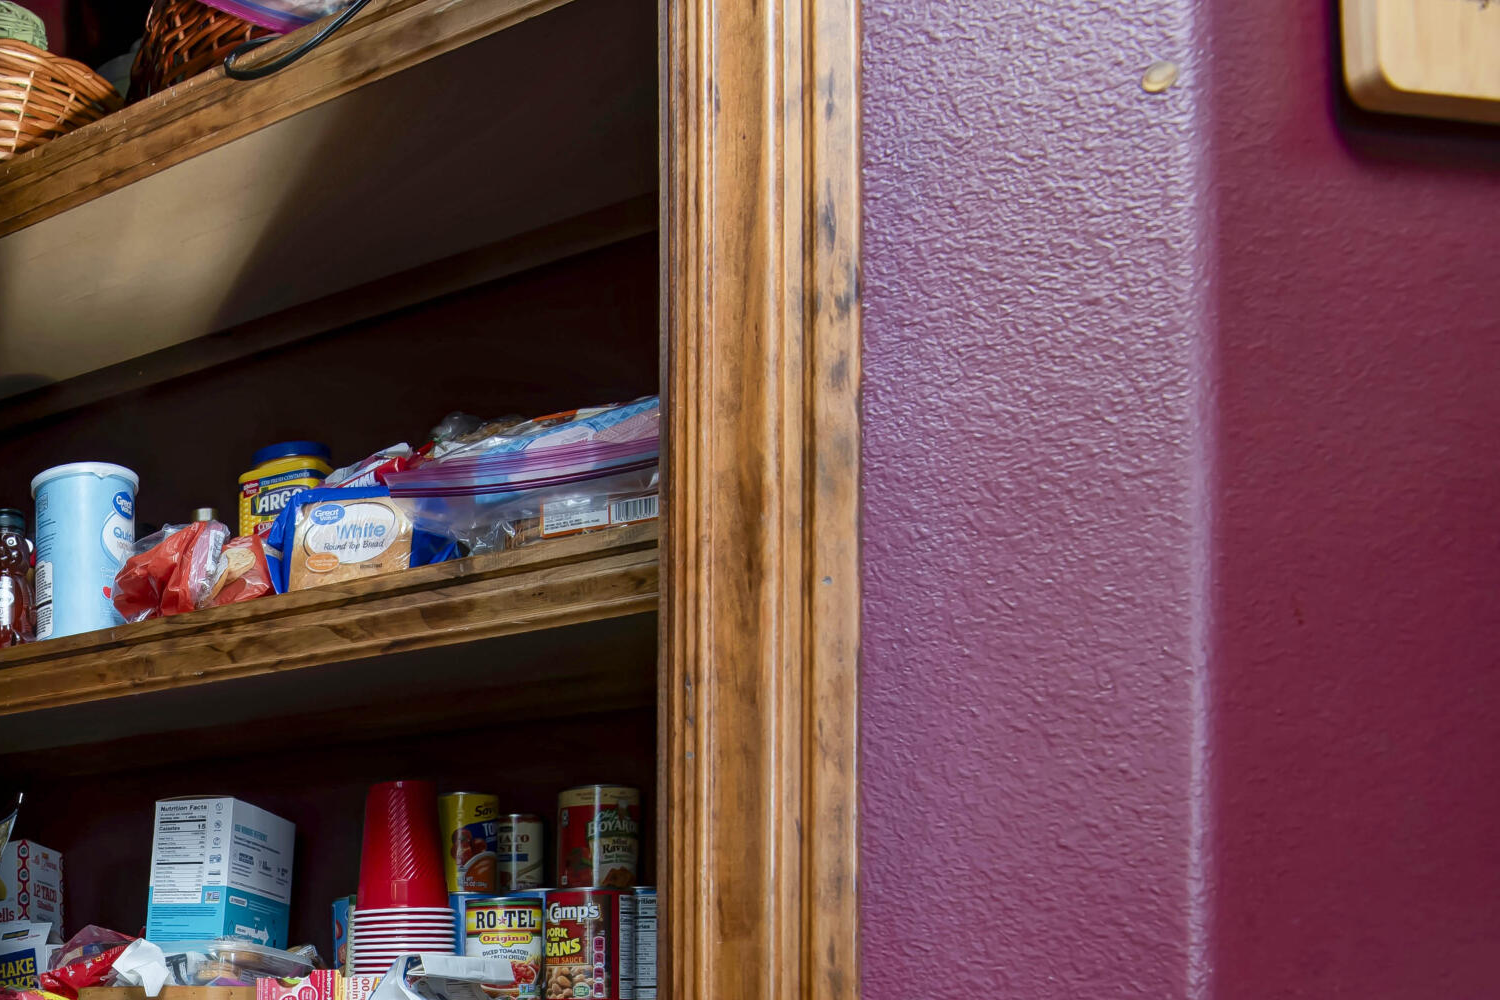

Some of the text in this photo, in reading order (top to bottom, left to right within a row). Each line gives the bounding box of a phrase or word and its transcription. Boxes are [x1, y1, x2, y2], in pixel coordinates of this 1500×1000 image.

[115, 495, 132, 509] Great
[314, 509, 340, 518] Great
[257, 521, 274, 530] COR
[336, 522, 387, 540] White
[112, 526, 134, 541] Quic
[323, 539, 385, 552] Round Top Bread
[160, 803, 208, 813] Nutrition Facts
[549, 902, 600, 923] Camp's
[482, 935, 529, 944] Original
[546, 938, 581, 957] EANS
[561, 956, 583, 964] SAUCE
